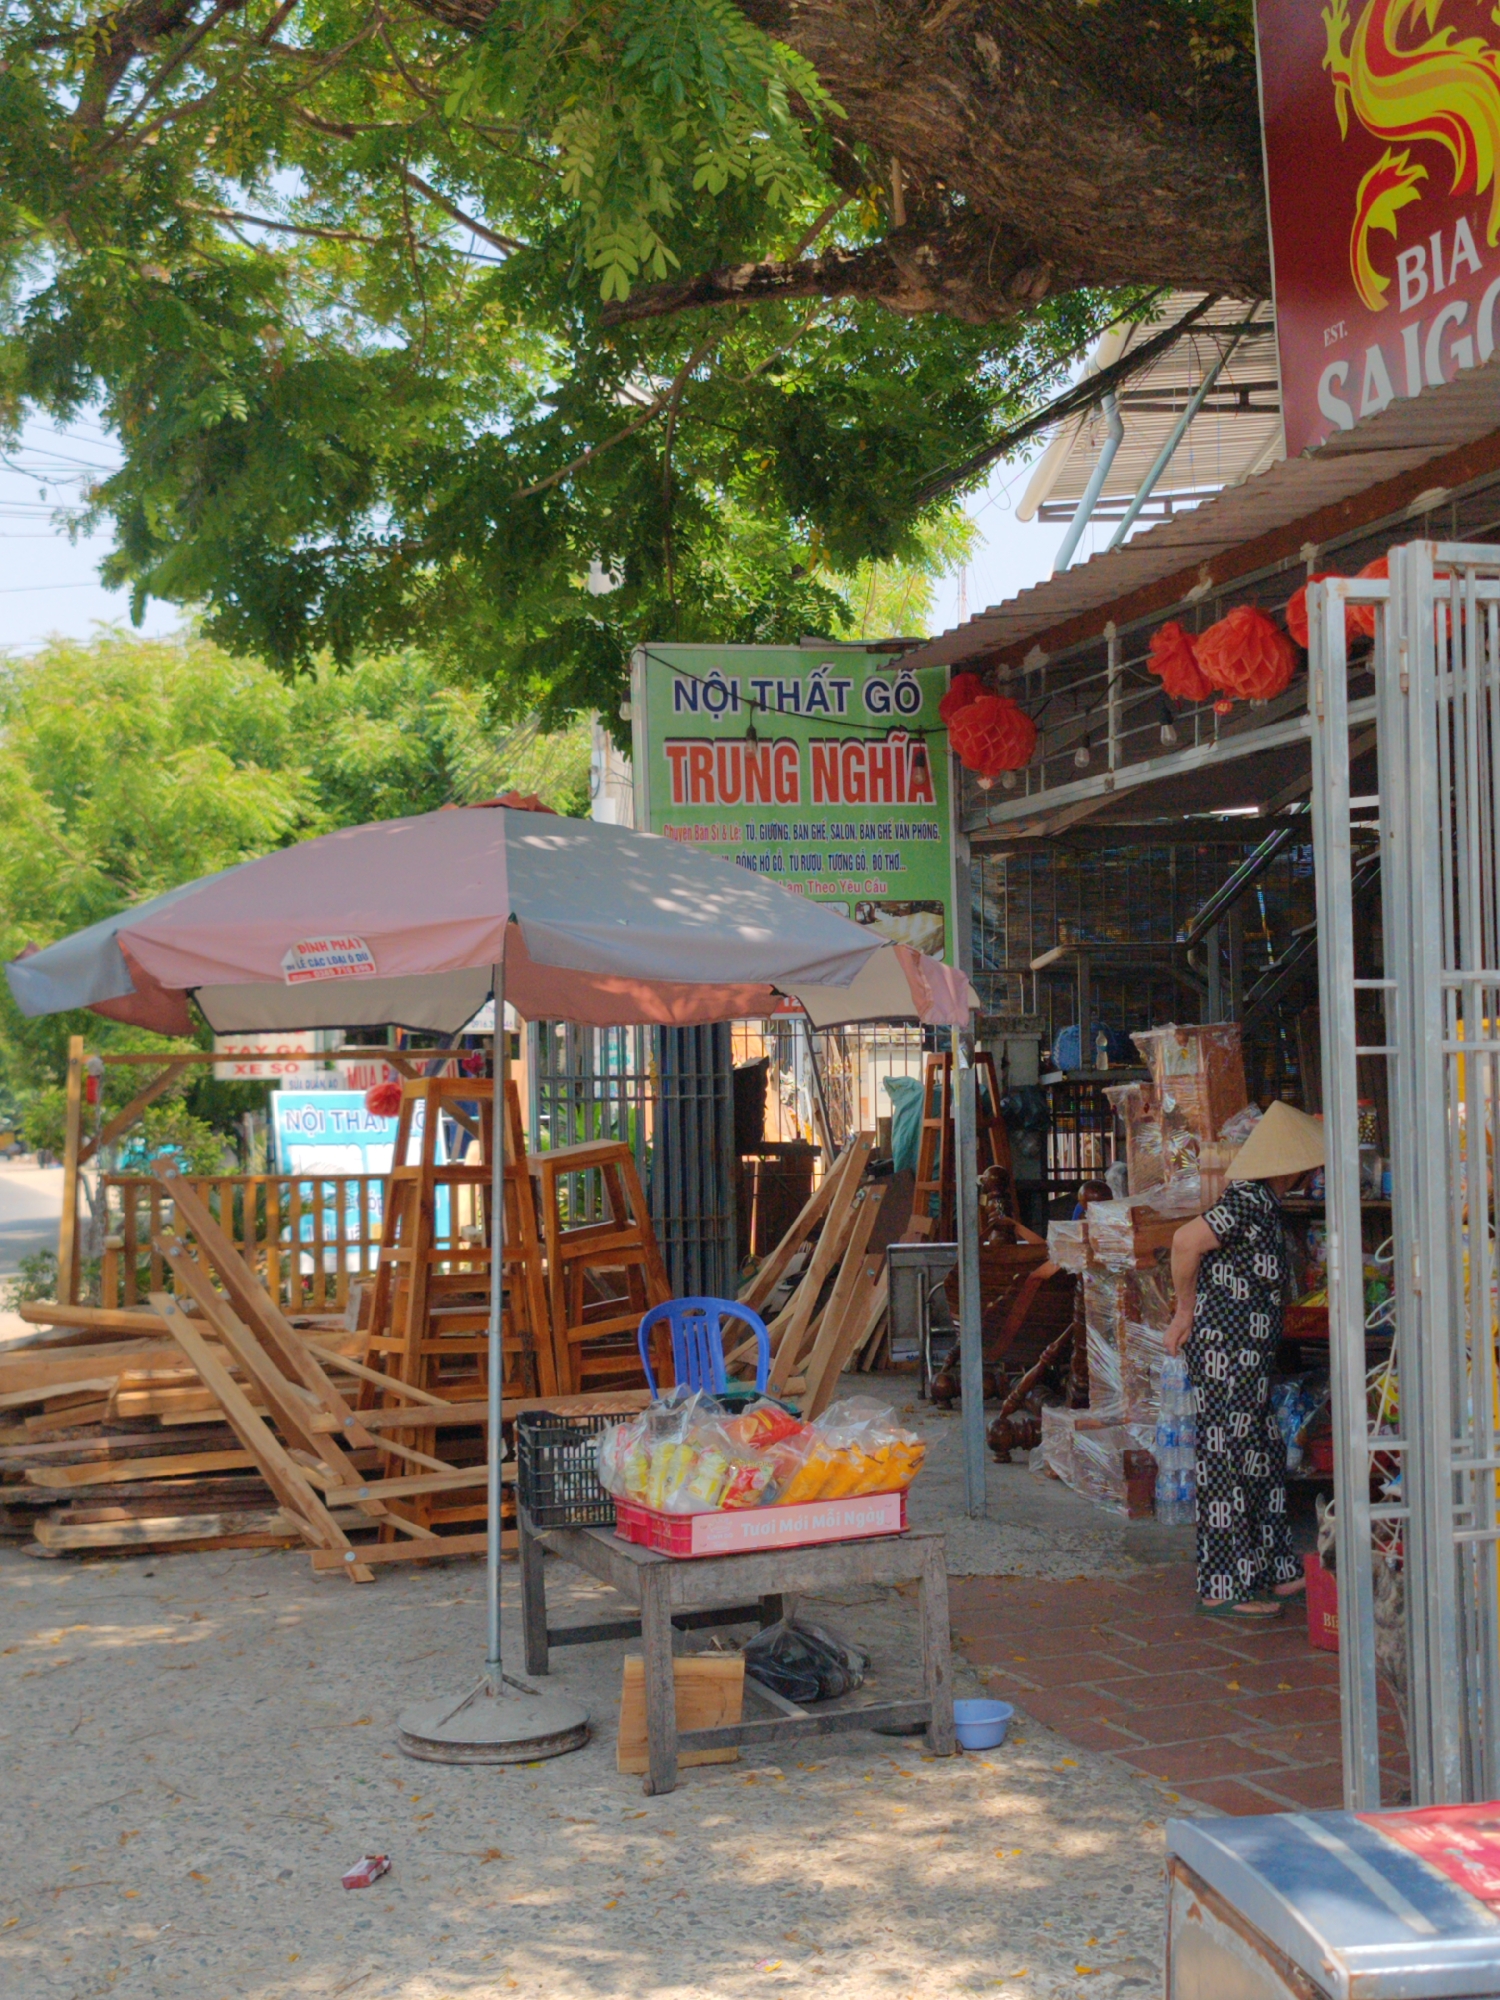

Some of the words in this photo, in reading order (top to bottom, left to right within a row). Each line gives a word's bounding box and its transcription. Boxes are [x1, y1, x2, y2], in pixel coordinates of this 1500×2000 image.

[1396, 216, 1483, 313] BIA
[1323, 320, 1348, 347] EST.
[1317, 276, 1500, 445] SAIG
[673, 670, 739, 719] NỘI
[751, 664, 851, 712] THẤT
[864, 670, 922, 714] GỖ
[665, 741, 799, 804] TRUNG
[811, 731, 935, 804] NGHĨA
[721, 824, 728, 841] &
[830, 823, 858, 842] SALON,
[807, 880, 836, 894] Theo
[839, 879, 863, 894] Yêu
[864, 877, 887, 894] Cầu
[234, 1063, 263, 1075] XE
[285, 1104, 325, 1136] NỘI
[741, 1518, 776, 1537] Tươi
[780, 1516, 809, 1534] Mới
[813, 1507, 841, 1530] Mỗi
[844, 1506, 886, 1529] Ngày
